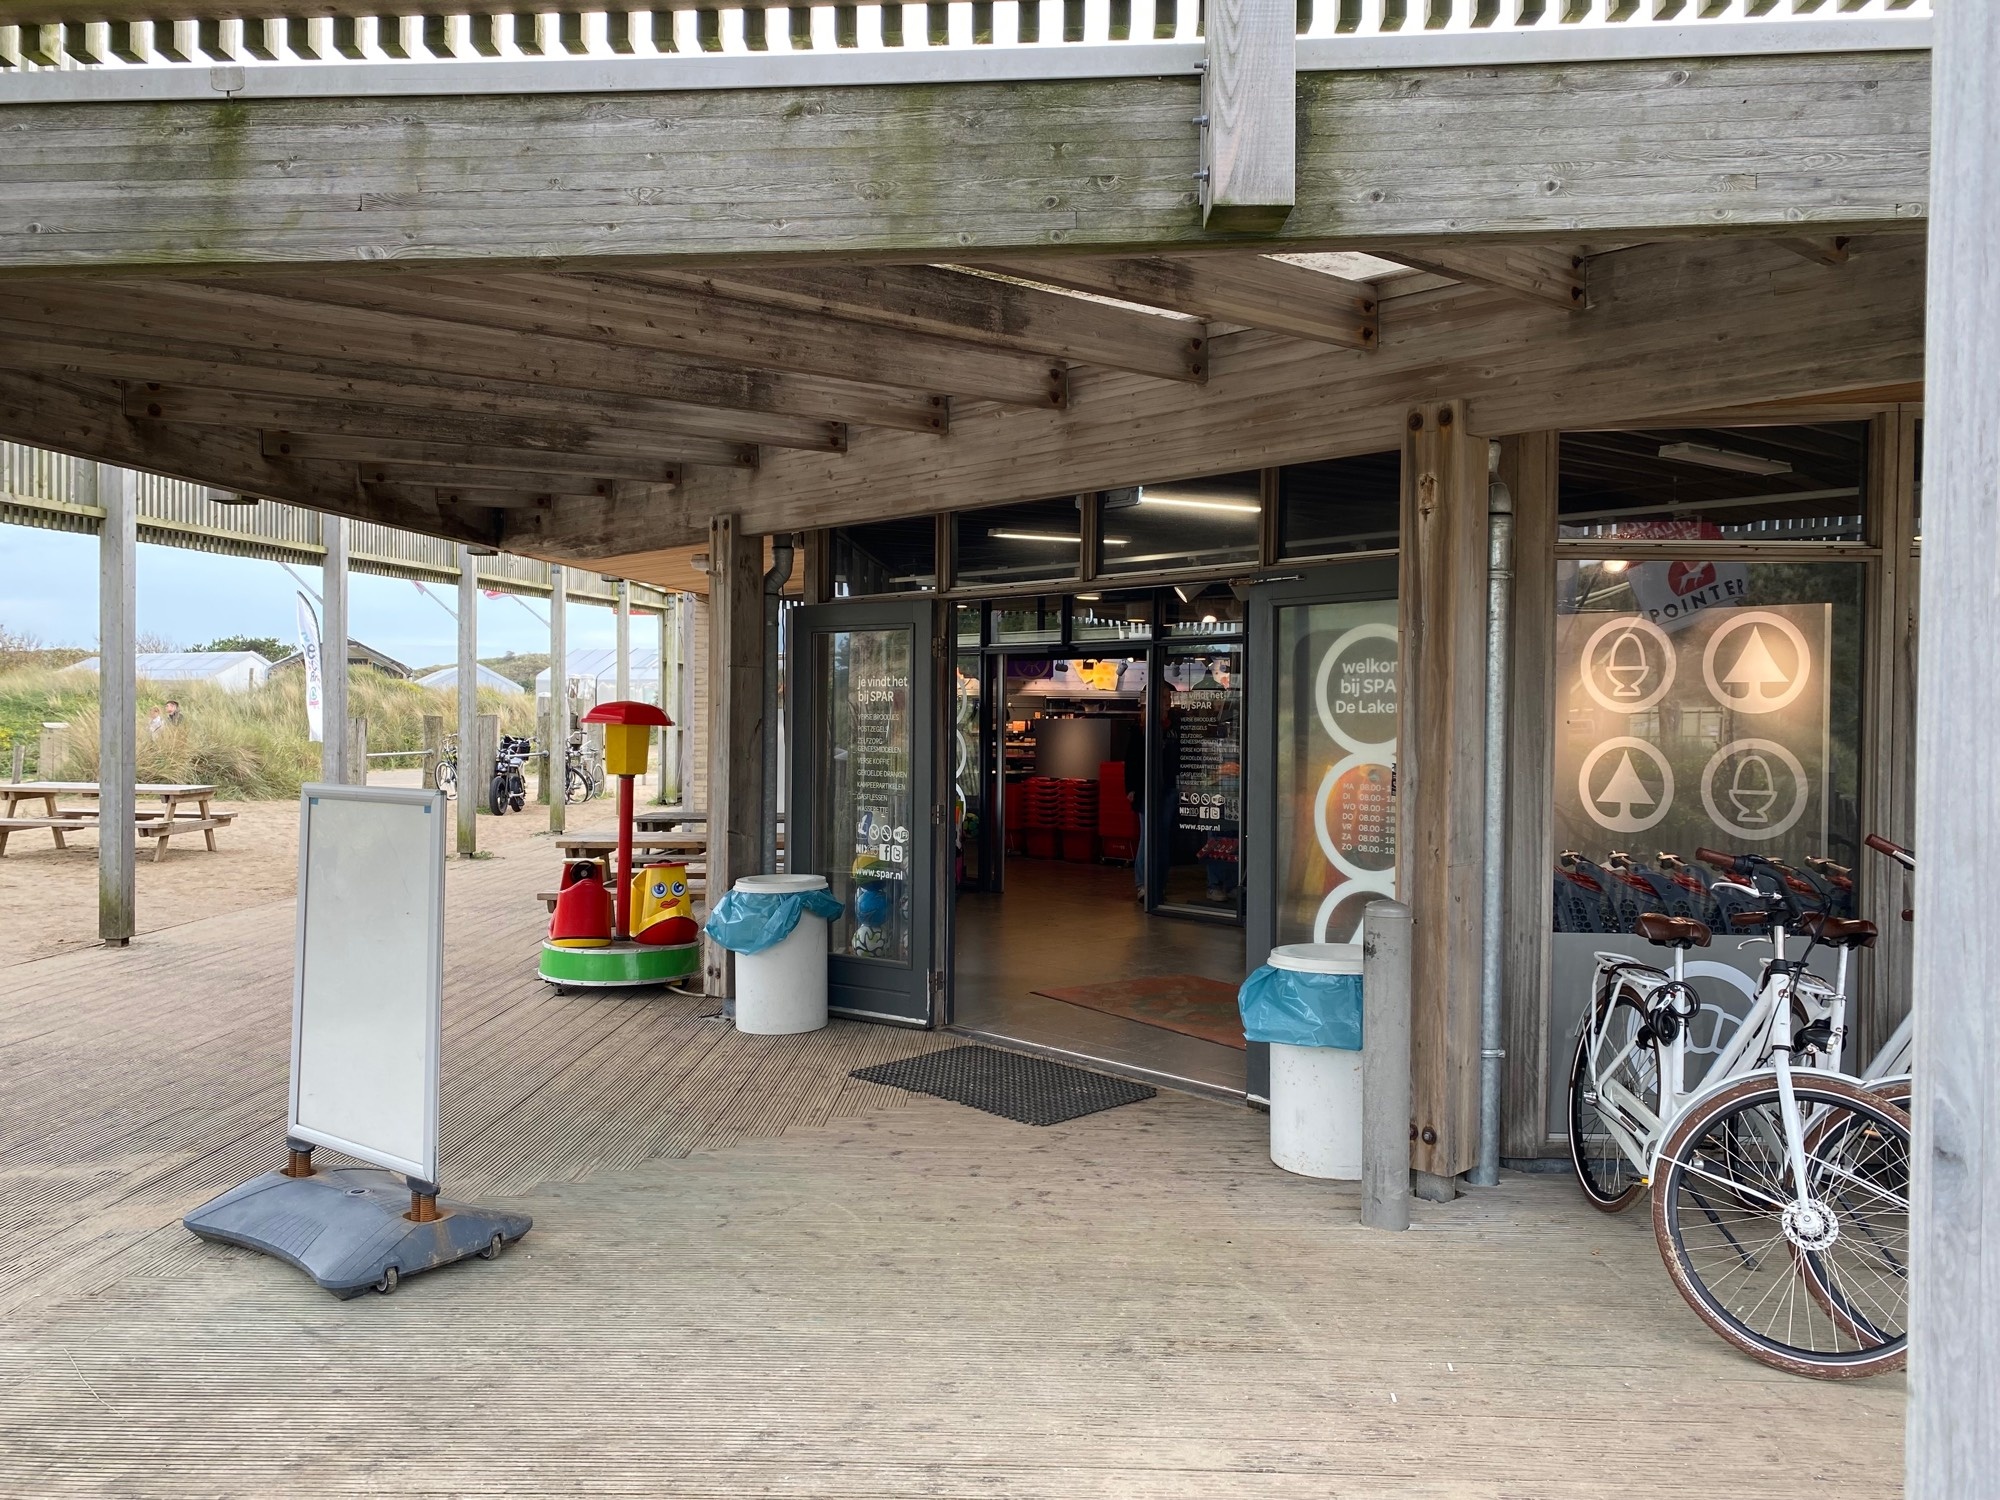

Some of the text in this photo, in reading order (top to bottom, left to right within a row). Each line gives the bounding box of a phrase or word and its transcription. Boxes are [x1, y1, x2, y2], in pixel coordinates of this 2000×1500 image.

[1649, 579, 1744, 623] POINTER
[857, 675, 908, 690] je vindt het
[1340, 678, 1397, 697] bij SPA
[858, 690, 894, 704] bij SPAR
[1191, 701, 1212, 709] SPAR
[1336, 699, 1397, 713] De Lake
[857, 725, 889, 733] POSTZEGELS
[857, 745, 902, 753] GENEESMIDDELEN
[857, 757, 872, 765] VERSE
[857, 769, 908, 779] GEKOELDE DRANKEN
[857, 781, 906, 790] KAMPEERARTIKELEN
[1360, 783, 1381, 791] 08.00
[857, 793, 888, 802] GASFLESSEN
[1359, 793, 1381, 801] 08.00
[857, 805, 889, 814] WASSERETTE
[1359, 814, 1380, 822] 08.00
[1179, 823, 1221, 832] www.spar.nl
[1358, 824, 1380, 832] 08.00
[1358, 834, 1380, 842] 08.00
[1357, 844, 1379, 853] 08.00
[856, 868, 903, 880] www.spar.nl
